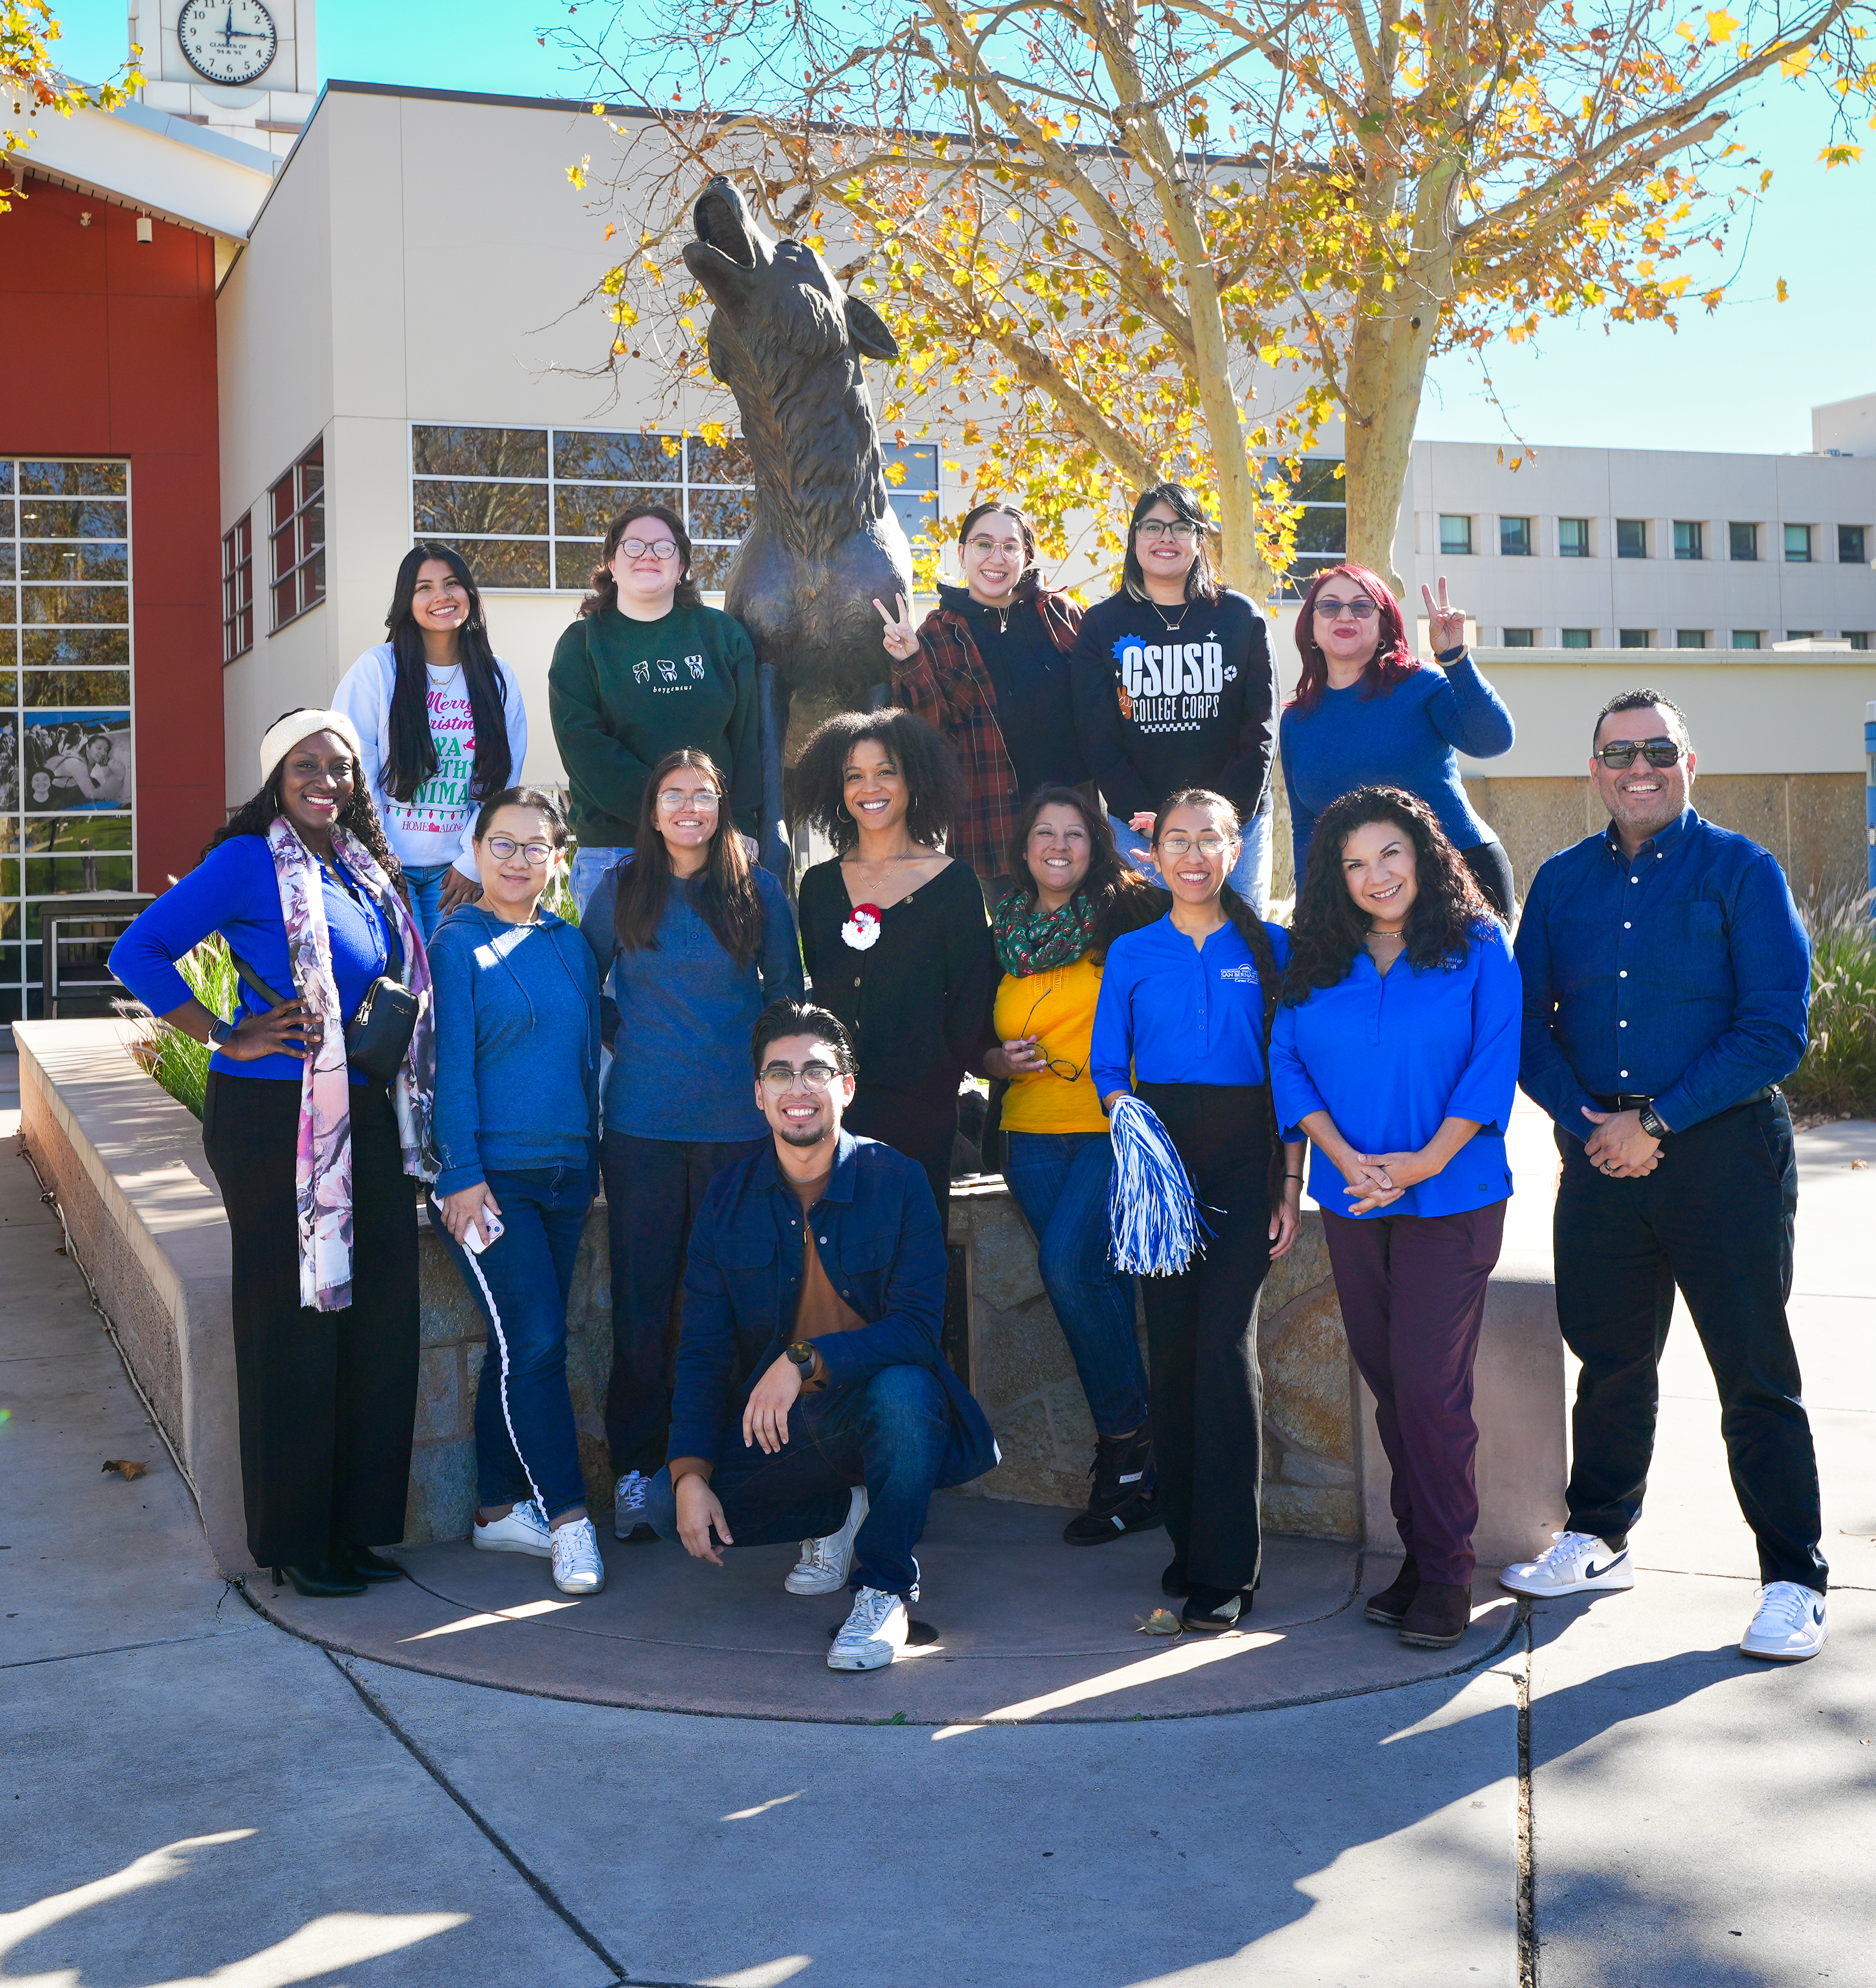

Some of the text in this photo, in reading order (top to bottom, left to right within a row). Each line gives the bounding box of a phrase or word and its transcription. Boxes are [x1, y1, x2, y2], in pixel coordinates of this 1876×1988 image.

[204, 0, 216, 8] 11
[242, 2, 247, 10] 1
[193, 10, 205, 20] 10
[254, 15, 261, 24] 2
[190, 27, 196, 36] 9
[195, 45, 202, 54] 8
[256, 49, 262, 58] 4
[209, 58, 215, 67] 7
[244, 61, 250, 70] 5
[226, 64, 233, 73] 6
[1122, 642, 1223, 699] CSUSB
[653, 685, 693, 694] boygenius
[426, 691, 472, 718] Merry
[1132, 694, 1220, 723] COLLEGE CORPS
[429, 716, 474, 730] ristm
[414, 781, 468, 805] NIMA
[402, 821, 429, 832] HOME
